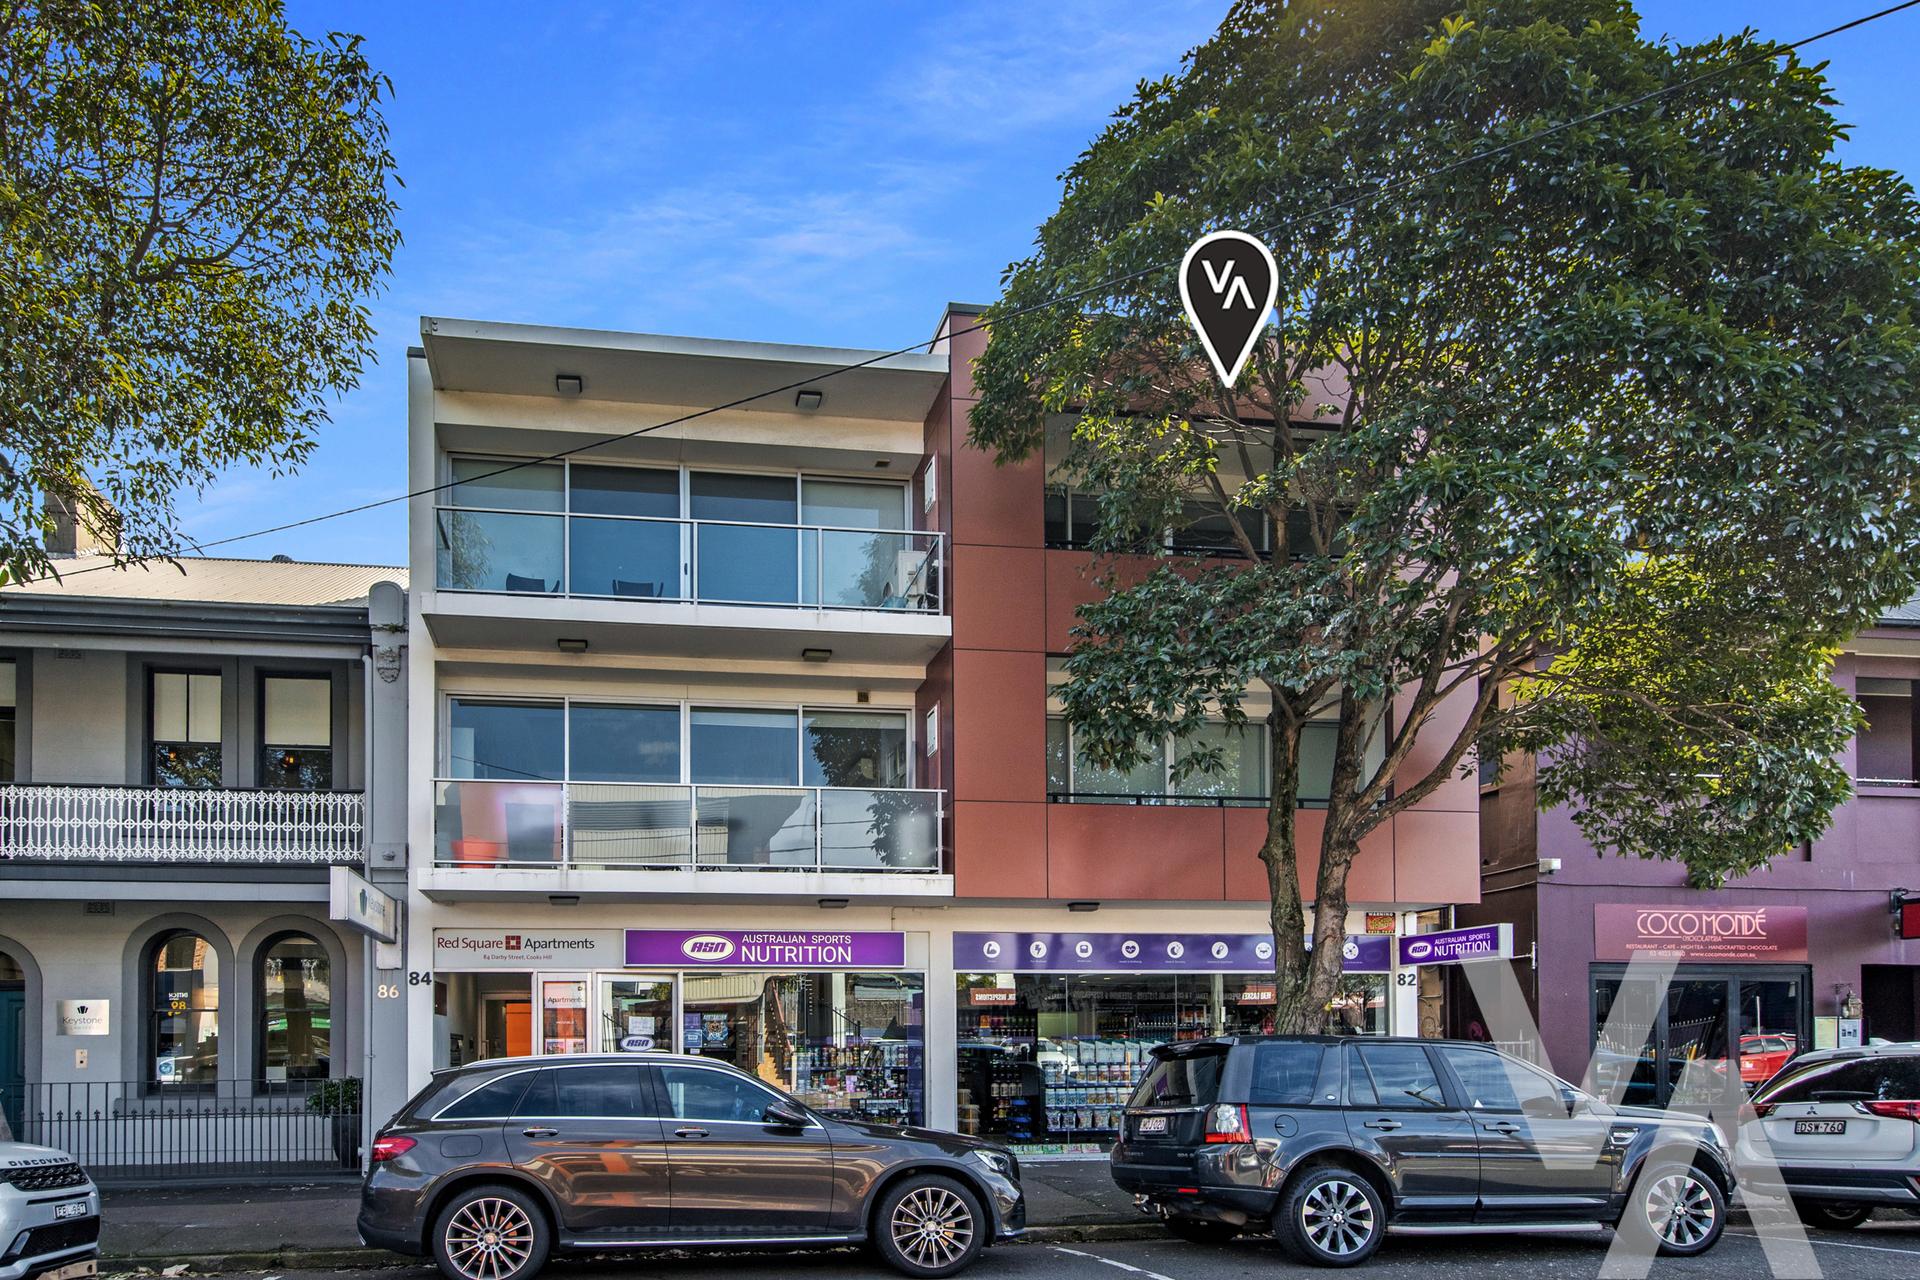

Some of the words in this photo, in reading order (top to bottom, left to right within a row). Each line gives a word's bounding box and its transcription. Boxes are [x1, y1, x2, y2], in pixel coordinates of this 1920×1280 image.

[437, 937, 459, 949] Red
[461, 937, 503, 952] Square
[524, 938, 595, 953] Apartments
[742, 934, 806, 944] AUSTRALIAN
[811, 934, 852, 944] SPORTS
[1434, 936, 1467, 945] AUSTRALIAN
[1468, 932, 1491, 942] SPORTS
[741, 946, 852, 962] NUTRITION
[1434, 940, 1491, 957] NUTRITION
[491, 954, 507, 962] Darby
[408, 971, 433, 986] 84
[1397, 973, 1416, 986] 82
[377, 984, 399, 998] 86
[63, 1016, 103, 1026] Keystone
[8, 1157, 70, 1167] DISCOVERY
